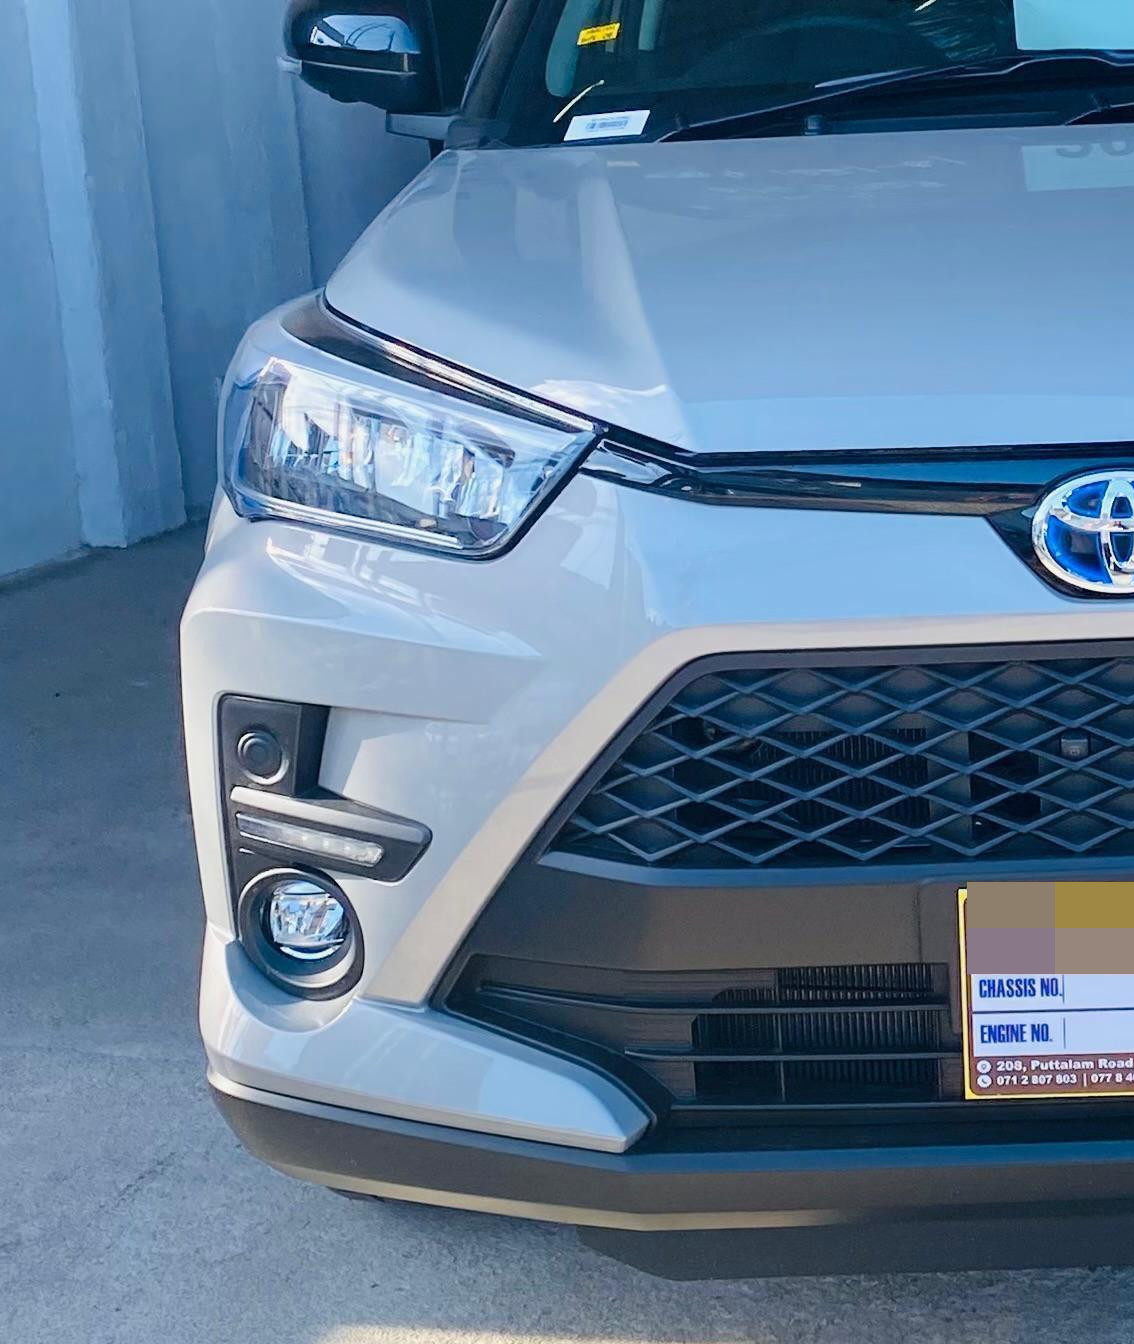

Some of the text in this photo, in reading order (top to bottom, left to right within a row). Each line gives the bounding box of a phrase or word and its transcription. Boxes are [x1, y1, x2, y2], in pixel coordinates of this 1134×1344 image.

[979, 977, 1063, 998] CHASSIS NO.
[980, 1023, 1053, 1044] ENGINE NO.
[996, 1060, 1027, 1073] 208,
[1031, 1058, 1094, 1071] Puttalam
[996, 1075, 1017, 1085] 071
[1021, 1075, 1028, 1085] 2
[1091, 1073, 1112, 1083] 077
